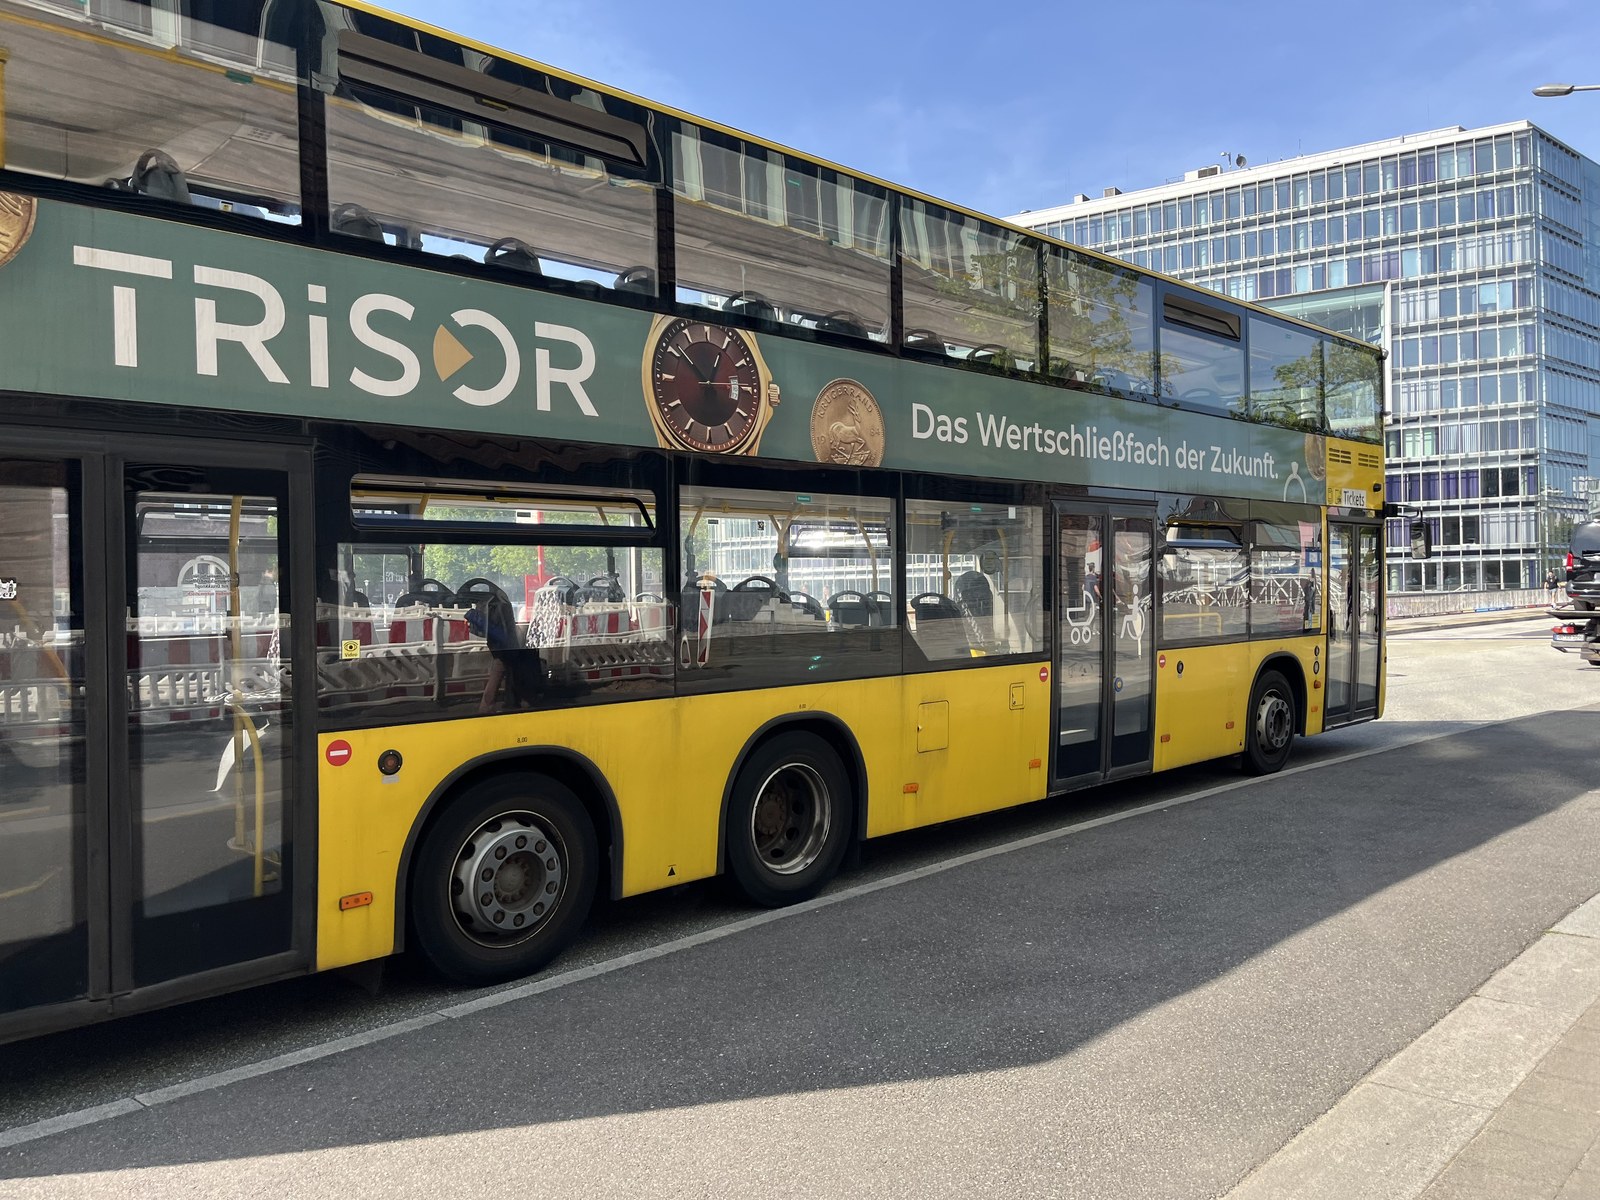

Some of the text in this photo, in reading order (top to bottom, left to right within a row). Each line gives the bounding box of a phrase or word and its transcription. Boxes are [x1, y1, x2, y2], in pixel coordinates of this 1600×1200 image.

[818, 386, 873, 419] KRUGERRAND
[912, 402, 1279, 479] Das Wertschließfach der Zukunft.
[1343, 490, 1365, 507] Tickets
